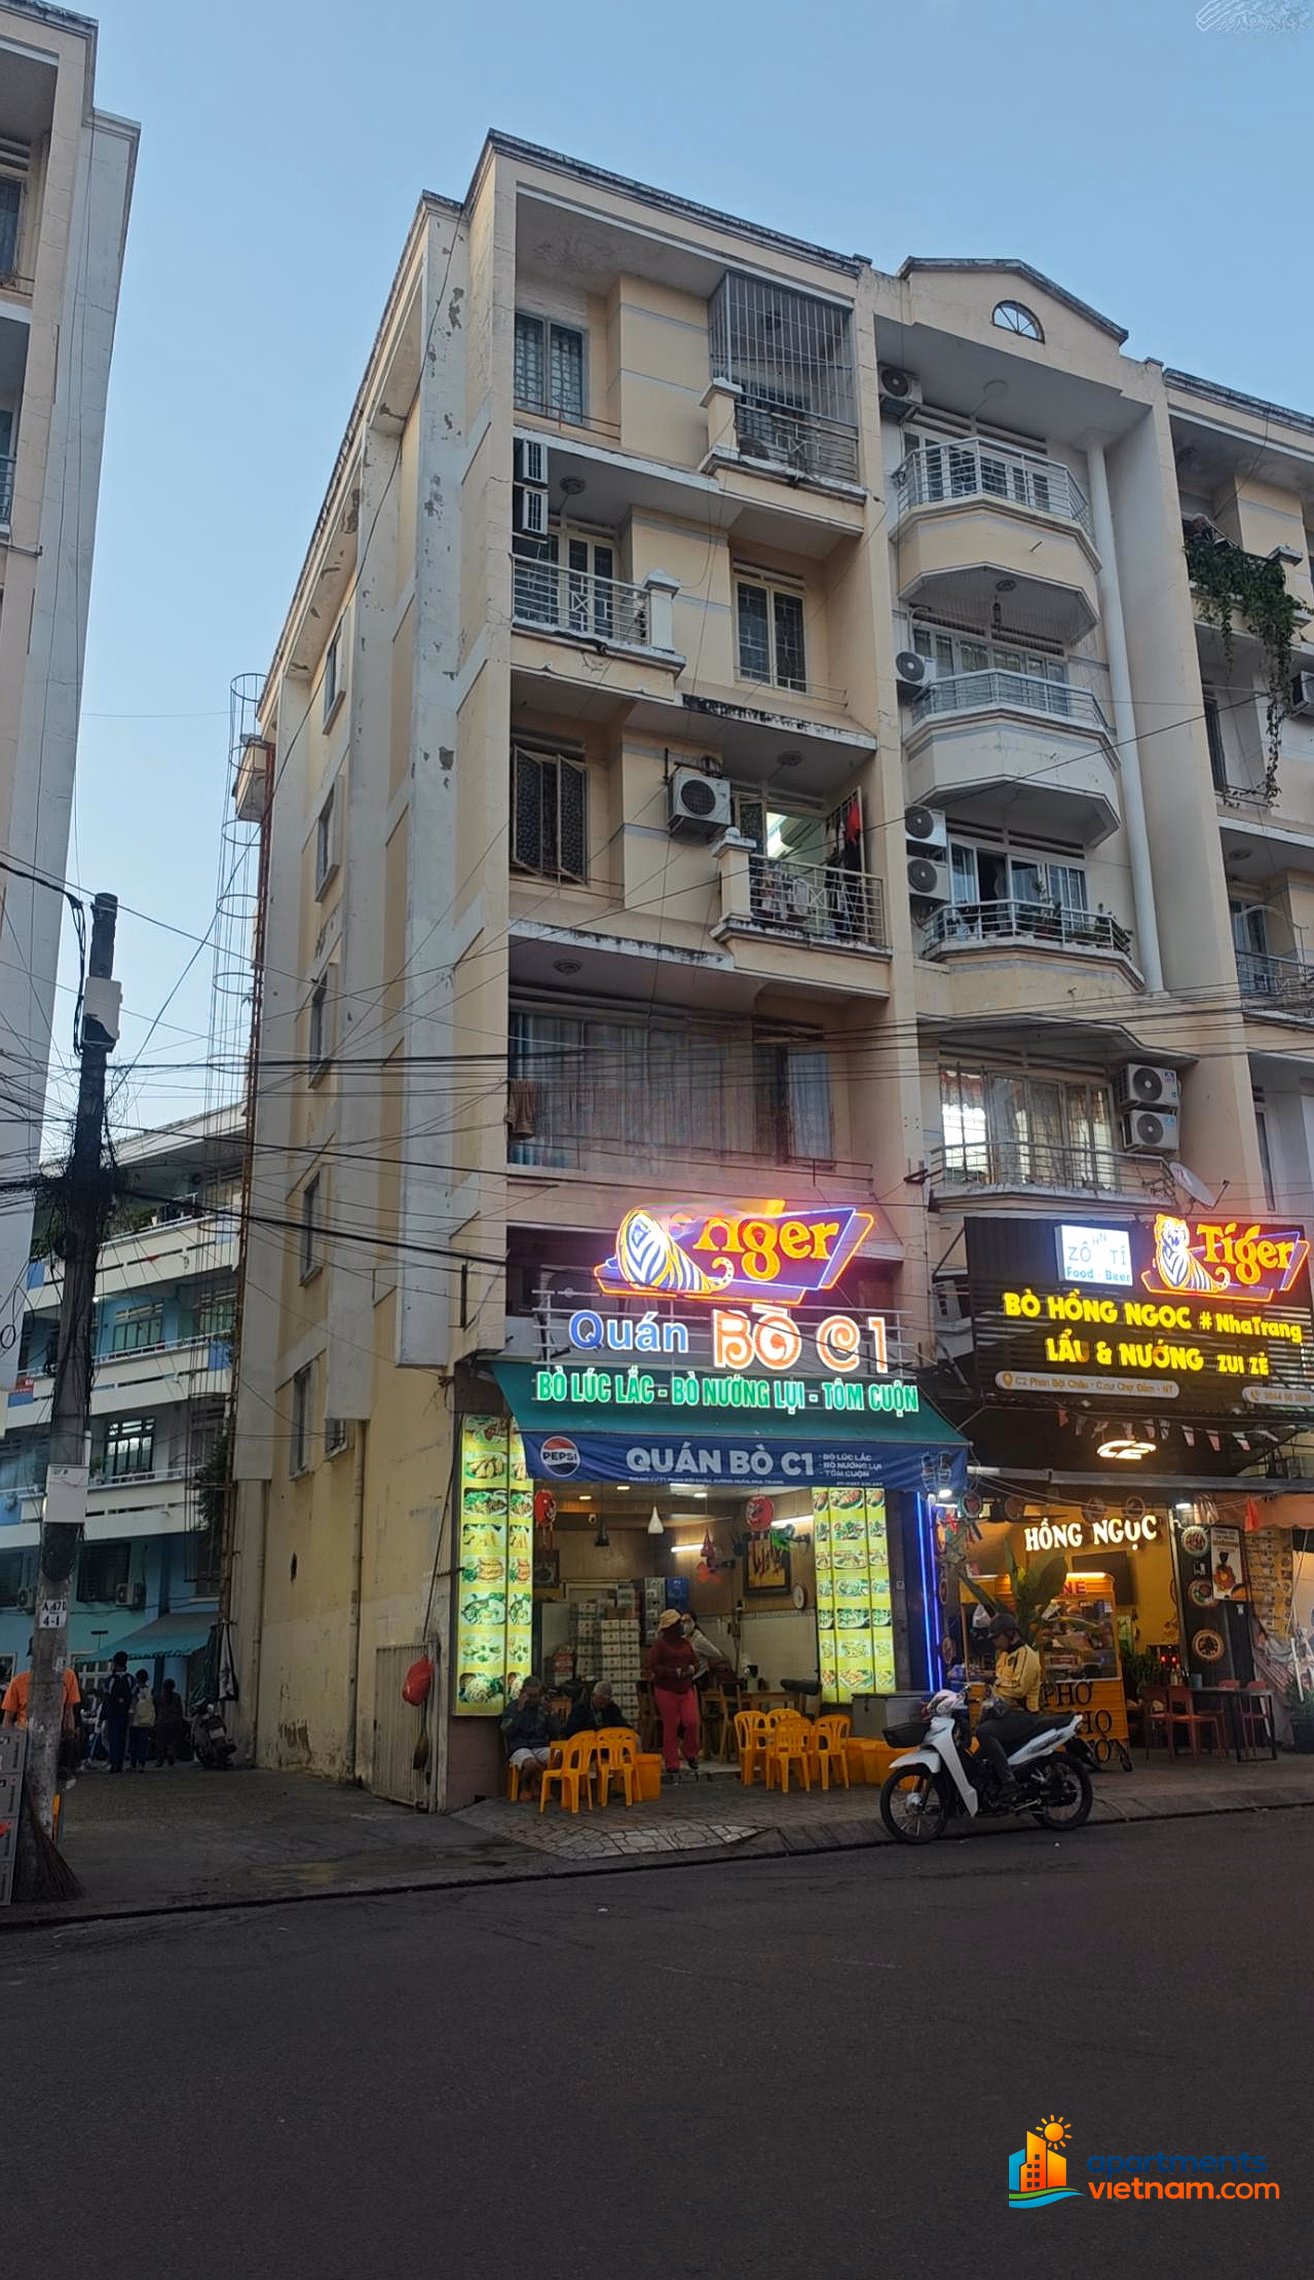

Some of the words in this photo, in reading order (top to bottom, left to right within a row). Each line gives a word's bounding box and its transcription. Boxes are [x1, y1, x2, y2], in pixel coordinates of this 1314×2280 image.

[1196, 1222, 1295, 1285] Tiger
[1067, 1266, 1094, 1279] Food
[1105, 1269, 1130, 1282] Beer
[1003, 1288, 1040, 1318] BÒ
[1047, 1288, 1118, 1324] HỒNG
[568, 1310, 689, 1354] Quán
[1045, 1328, 1089, 1363] LẨU
[1096, 1341, 1112, 1365] &
[1118, 1339, 1204, 1371] NƯỚNG
[1217, 1354, 1245, 1374] ZUI
[537, 1365, 567, 1401] BÒ
[571, 1367, 611, 1403] LÚC
[615, 1365, 654, 1404] LẮC
[671, 1371, 699, 1405] BÒ
[702, 1374, 770, 1408] NƯỚNG
[774, 1380, 805, 1415] LỤI
[822, 1378, 865, 1411] TÔM
[868, 1379, 919, 1418] CUỘN
[543, 1451, 577, 1461] PEPSI
[626, 1441, 722, 1473] QUÁN
[729, 1444, 774, 1475] BÒ
[781, 1452, 814, 1476] C1
[1024, 1517, 1083, 1551] HỒNG
